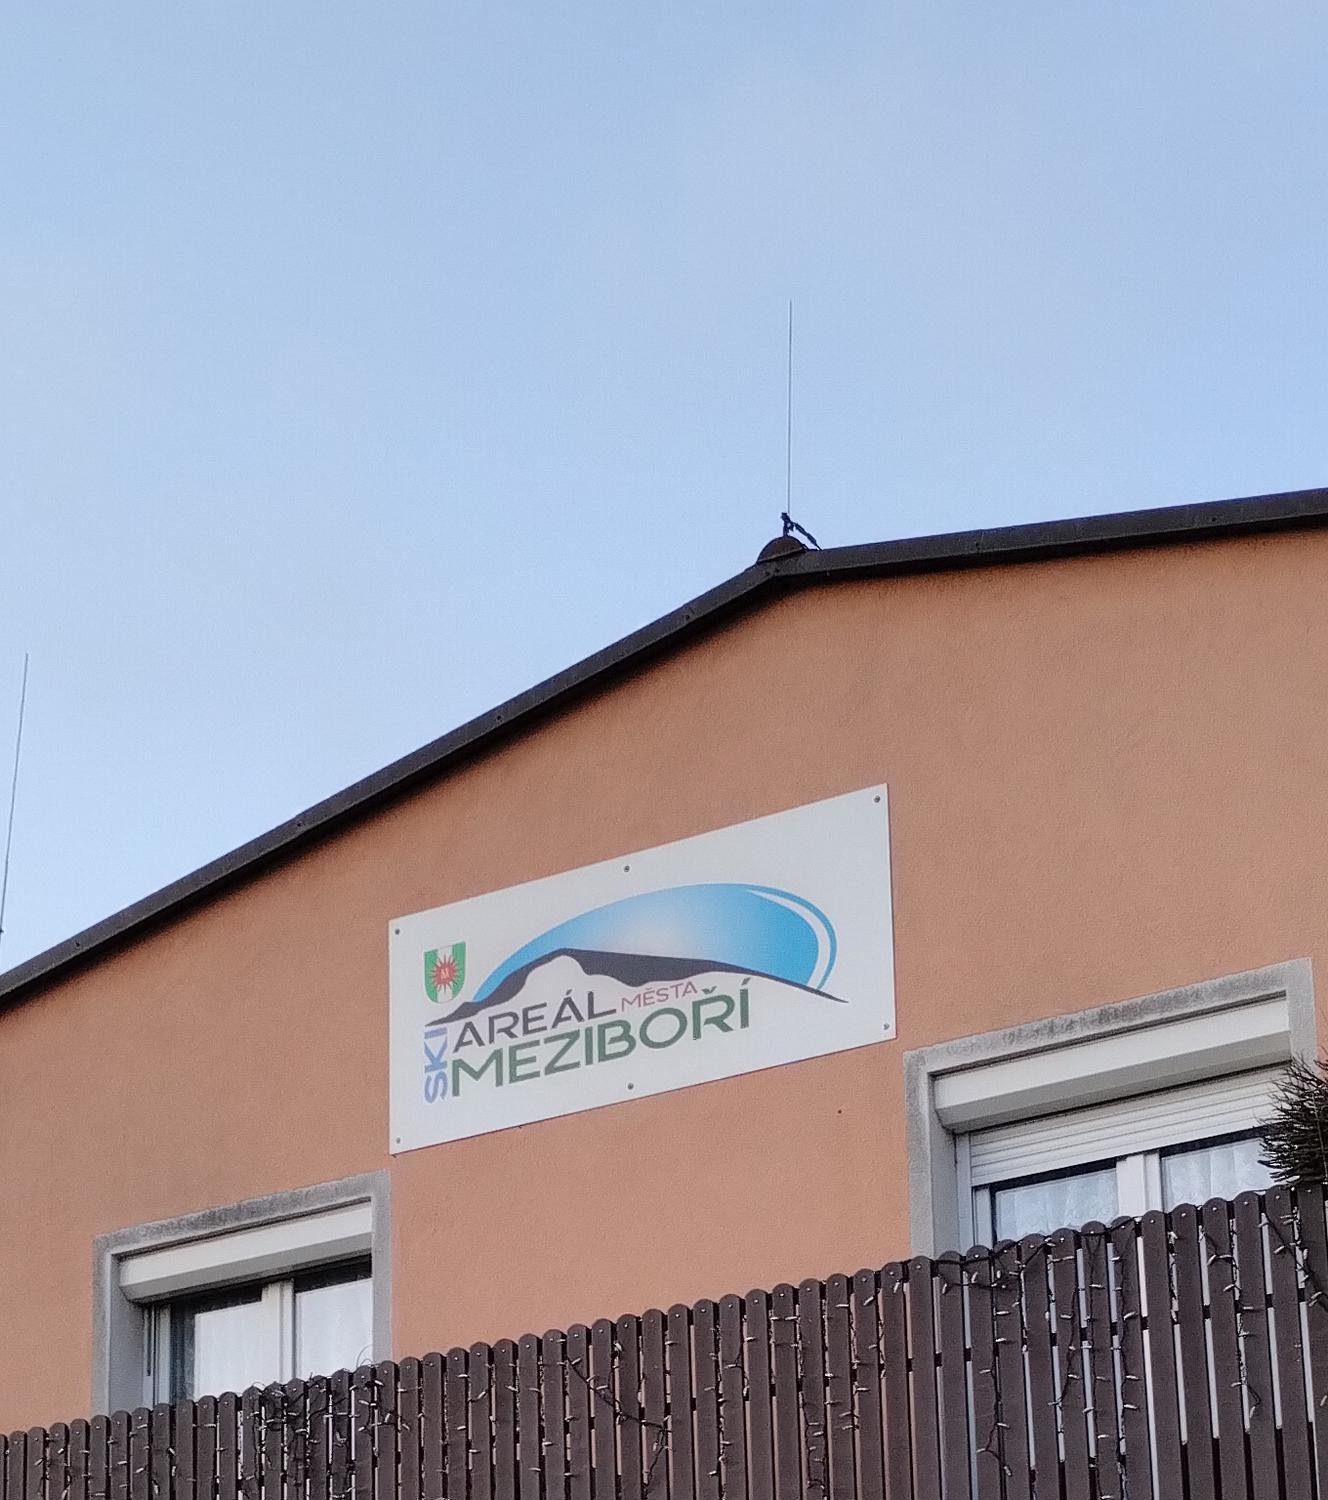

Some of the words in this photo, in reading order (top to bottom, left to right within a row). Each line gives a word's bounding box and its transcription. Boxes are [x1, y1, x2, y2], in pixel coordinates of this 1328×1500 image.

[450, 977, 751, 1097] MEZIBOŘÍ
[452, 988, 617, 1053] AREÁL
[620, 981, 699, 1014] MĚSTA
[424, 1026, 448, 1104] SKI
